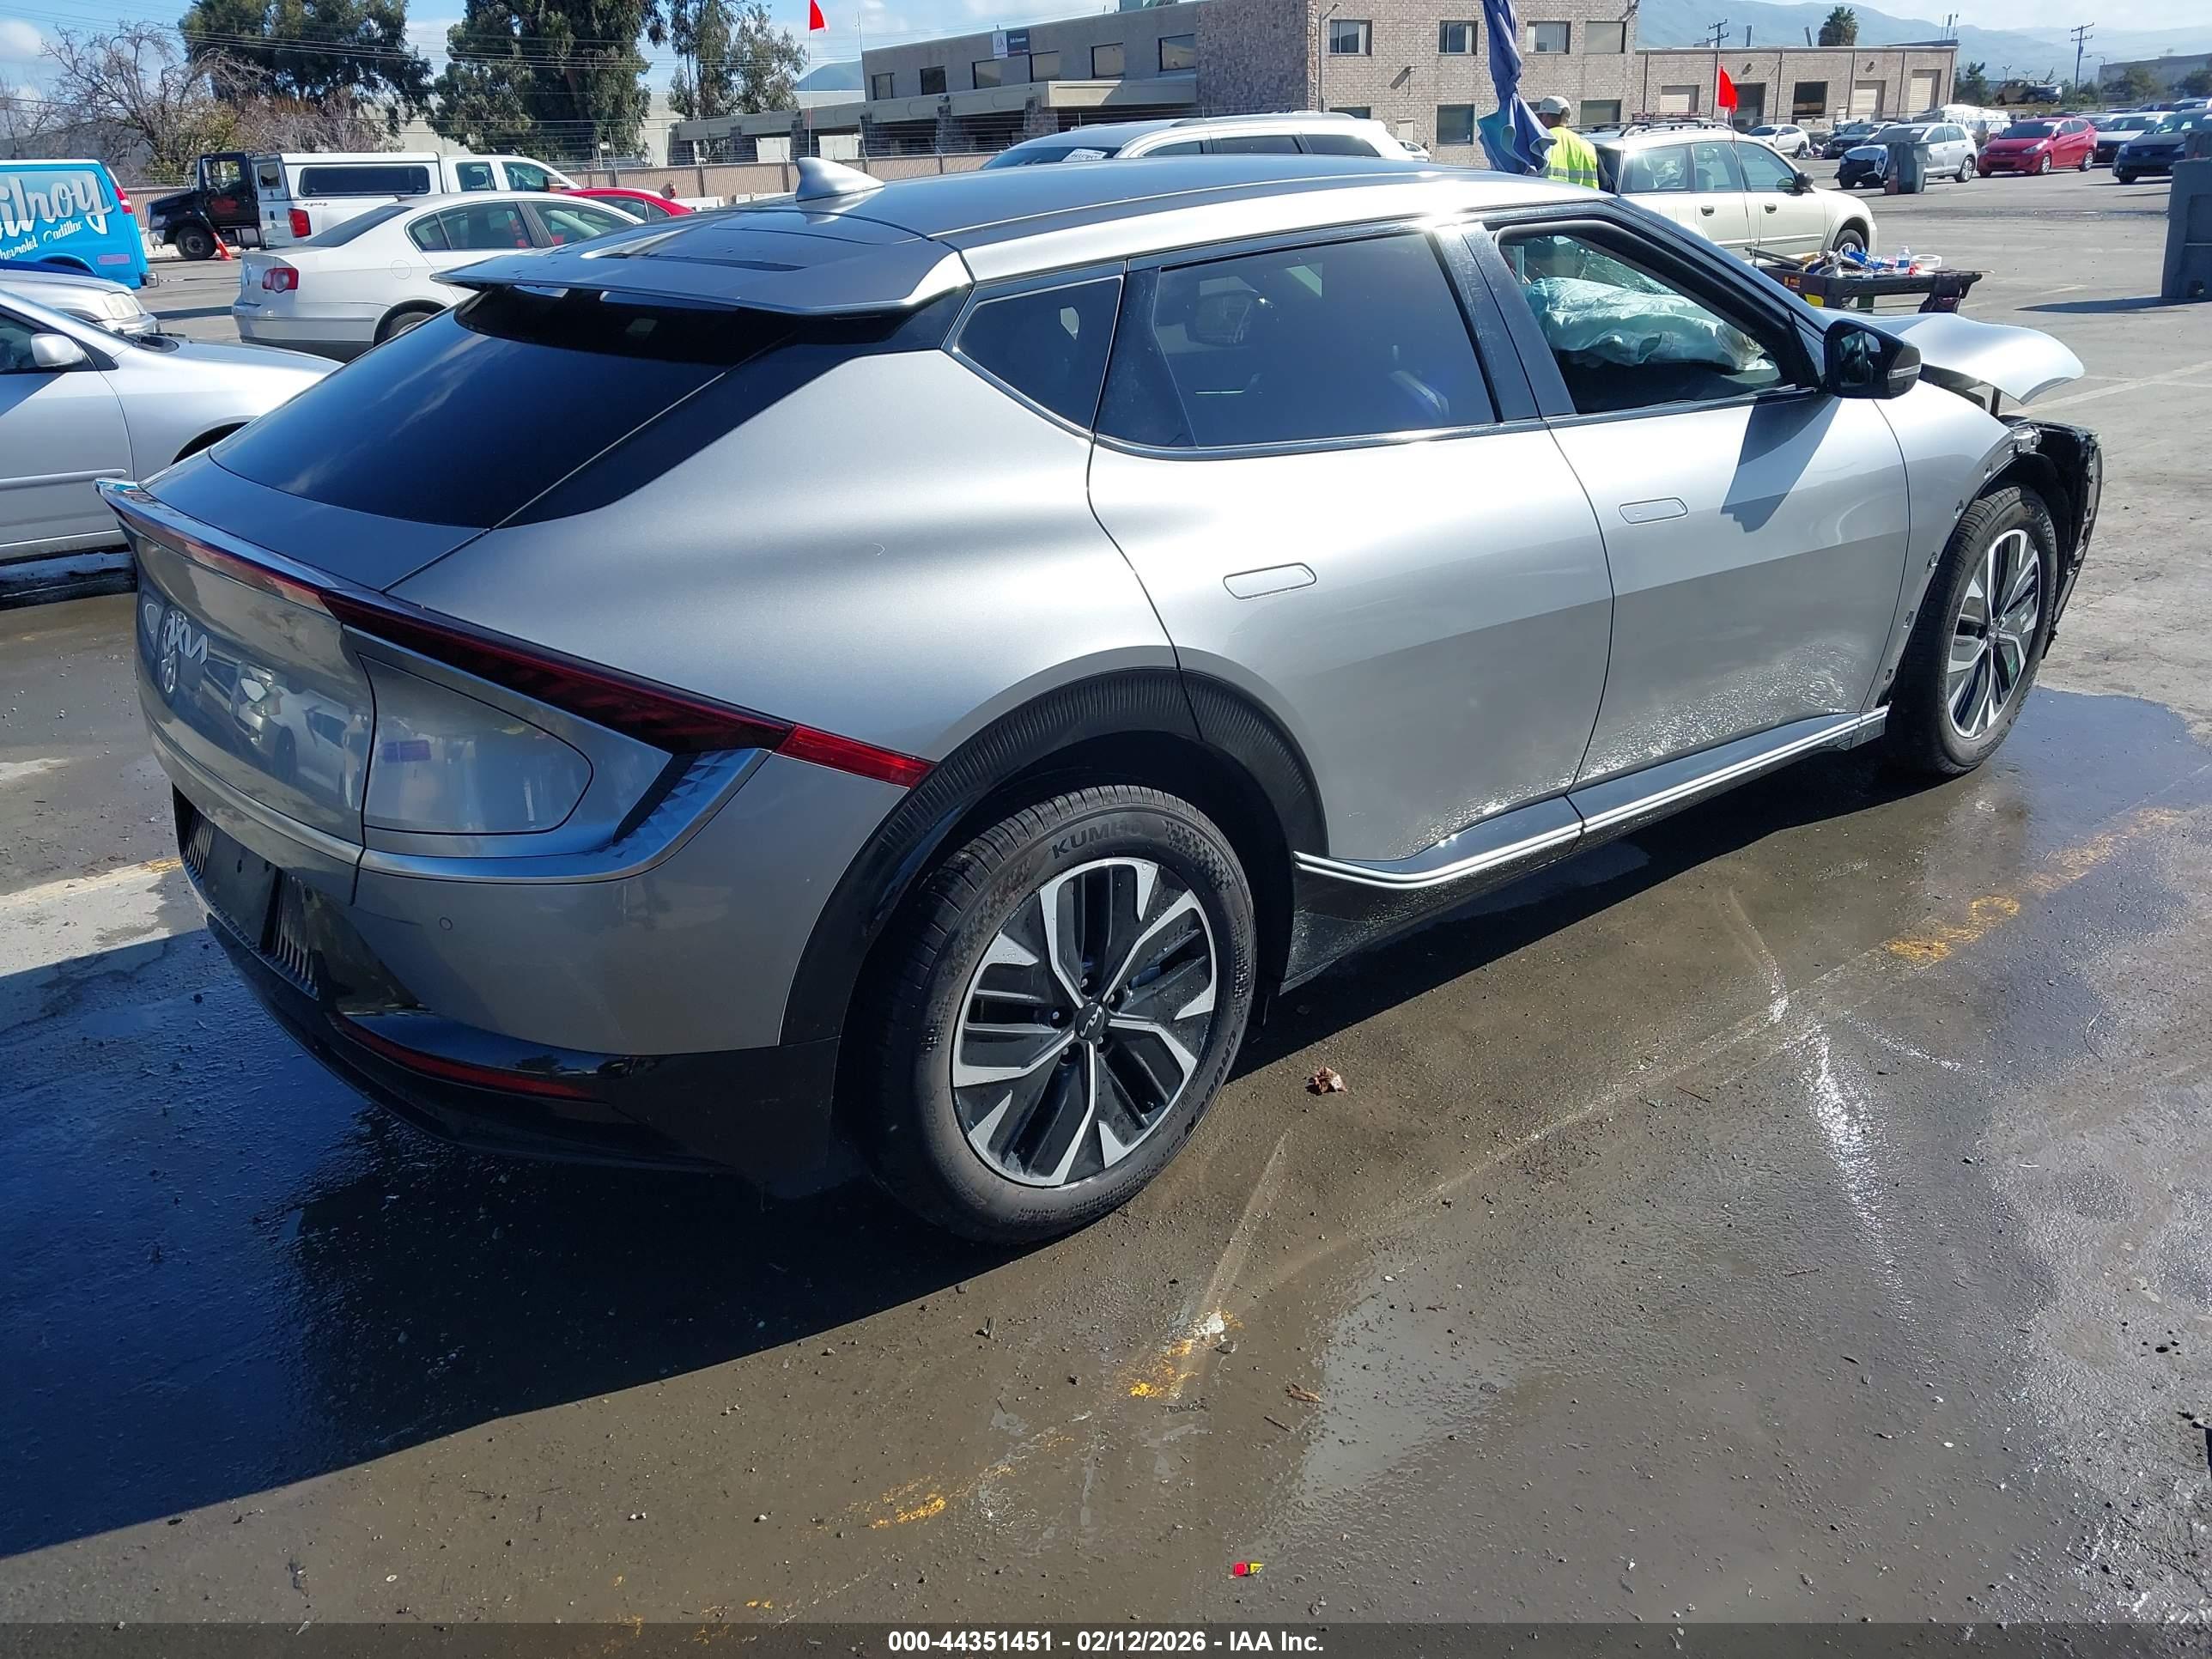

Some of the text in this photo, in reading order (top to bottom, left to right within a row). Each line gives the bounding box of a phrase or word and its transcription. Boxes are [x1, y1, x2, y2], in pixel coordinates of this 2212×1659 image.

[0, 172, 114, 237] ilroy
[0, 220, 83, 260] hevrolet Cadillac
